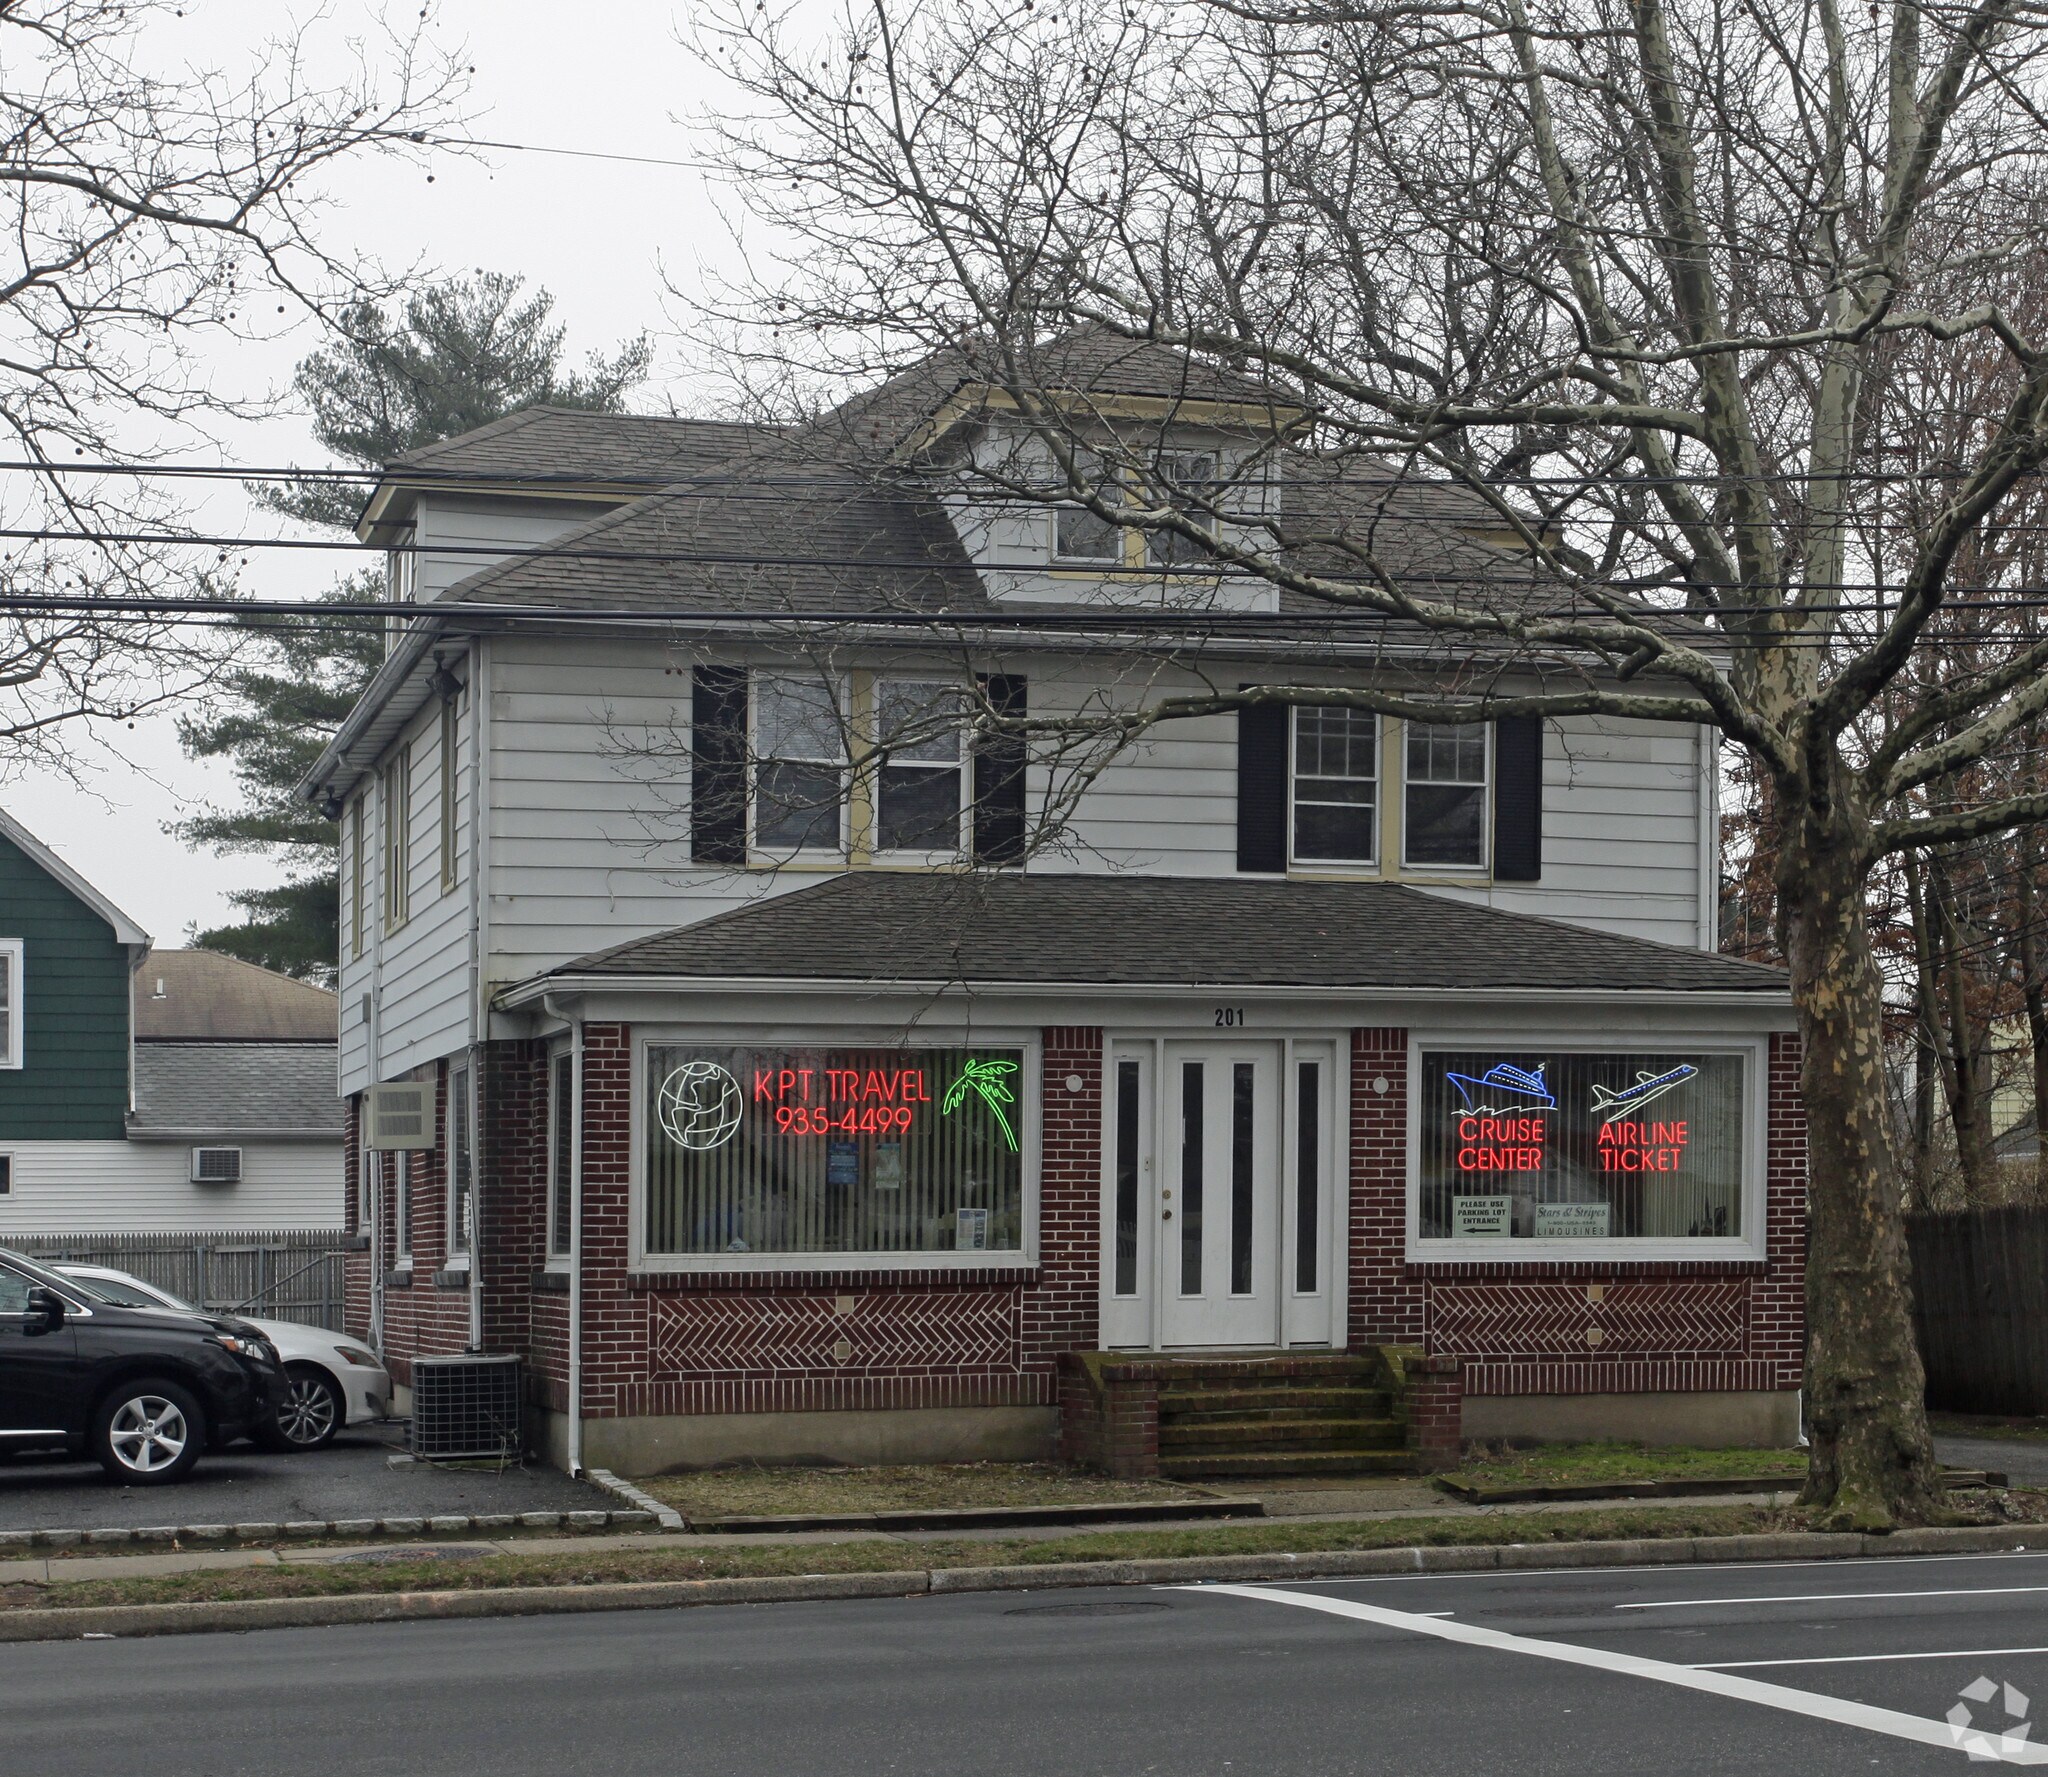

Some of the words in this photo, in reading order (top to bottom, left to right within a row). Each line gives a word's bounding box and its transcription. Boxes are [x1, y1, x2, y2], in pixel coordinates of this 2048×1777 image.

[1215, 1007, 1244, 1027] 201
[754, 1069, 815, 1102] KPT
[825, 1069, 931, 1102] TRAVEL
[776, 1106, 913, 1134] 935-4499
[1459, 1118, 1544, 1142] CRUISE
[1597, 1121, 1689, 1145] AIRLINE
[1457, 1148, 1543, 1170] CENTER
[1599, 1149, 1682, 1171] TICKET
[1537, 1206, 1561, 1217] Stars
[1563, 1207, 1573, 1217] &
[1574, 1206, 1606, 1220] Stripes
[1537, 1227, 1604, 1236] LIMOUSINES
